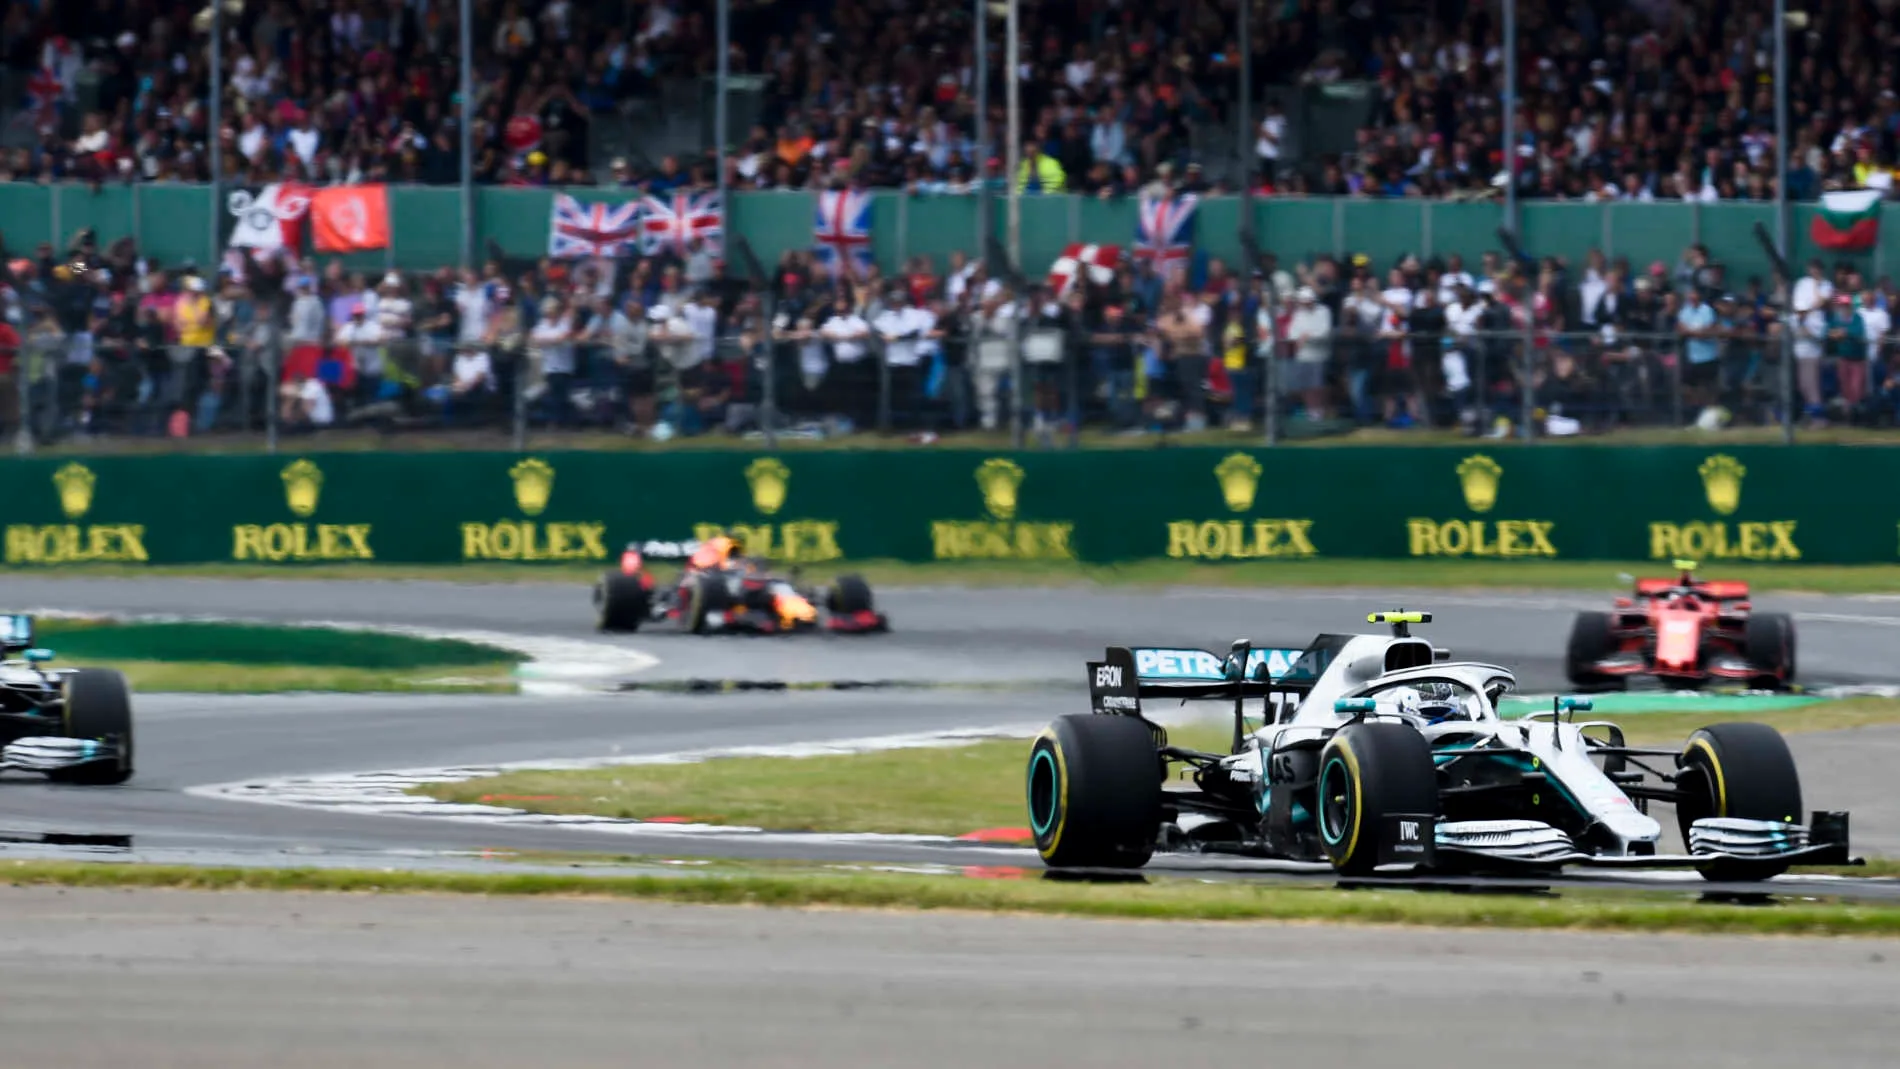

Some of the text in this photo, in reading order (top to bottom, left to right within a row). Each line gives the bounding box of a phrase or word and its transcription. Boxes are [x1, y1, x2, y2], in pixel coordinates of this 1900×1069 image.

[5, 524, 148, 562] ROLEX
[233, 523, 373, 559] ROLEX
[461, 522, 606, 559] ROLEX
[1167, 520, 1315, 557] ROLEX
[1407, 519, 1556, 555] ROLEX
[1649, 521, 1800, 558] ROLEX
[1135, 649, 1304, 676] PETRNA
[1400, 821, 1419, 840] IWC
